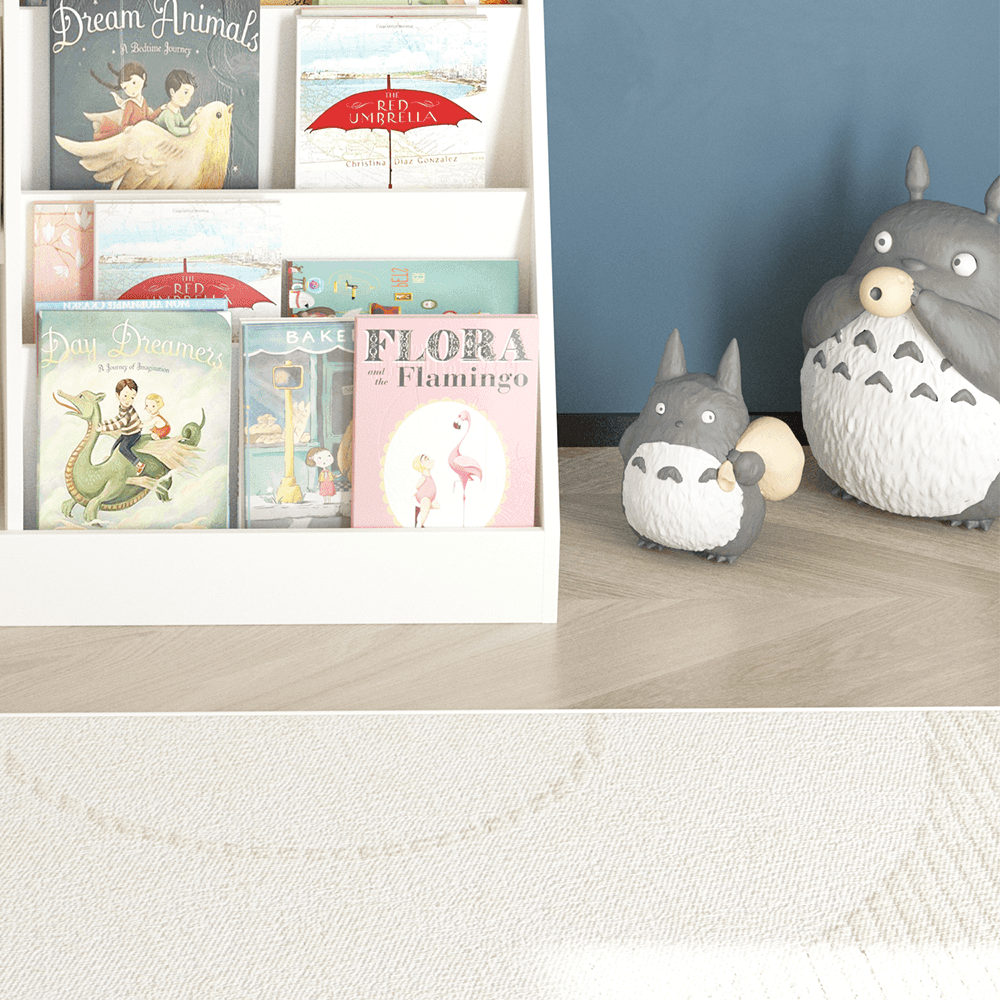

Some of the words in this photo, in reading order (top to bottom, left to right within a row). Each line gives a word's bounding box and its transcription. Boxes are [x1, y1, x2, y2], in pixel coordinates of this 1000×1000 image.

[52, 0, 145, 53] Dream
[131, 42, 161, 53] Bedtime
[164, 41, 192, 58] Journey
[377, 99, 408, 111] RED
[350, 111, 437, 125] UMBRELLA
[346, 160, 386, 168] Christina
[417, 156, 458, 164] Gonzalez
[174, 283, 205, 294] RED
[41, 326, 96, 368] Day
[108, 318, 223, 368] Dreamers
[286, 329, 354, 344] BAKE
[364, 328, 532, 362] FLORA
[106, 363, 128, 373] Journey
[129, 363, 136, 371] of
[137, 362, 170, 373] Imagination
[368, 368, 385, 376] and
[375, 377, 388, 386] the
[397, 366, 529, 394] Flamingo
